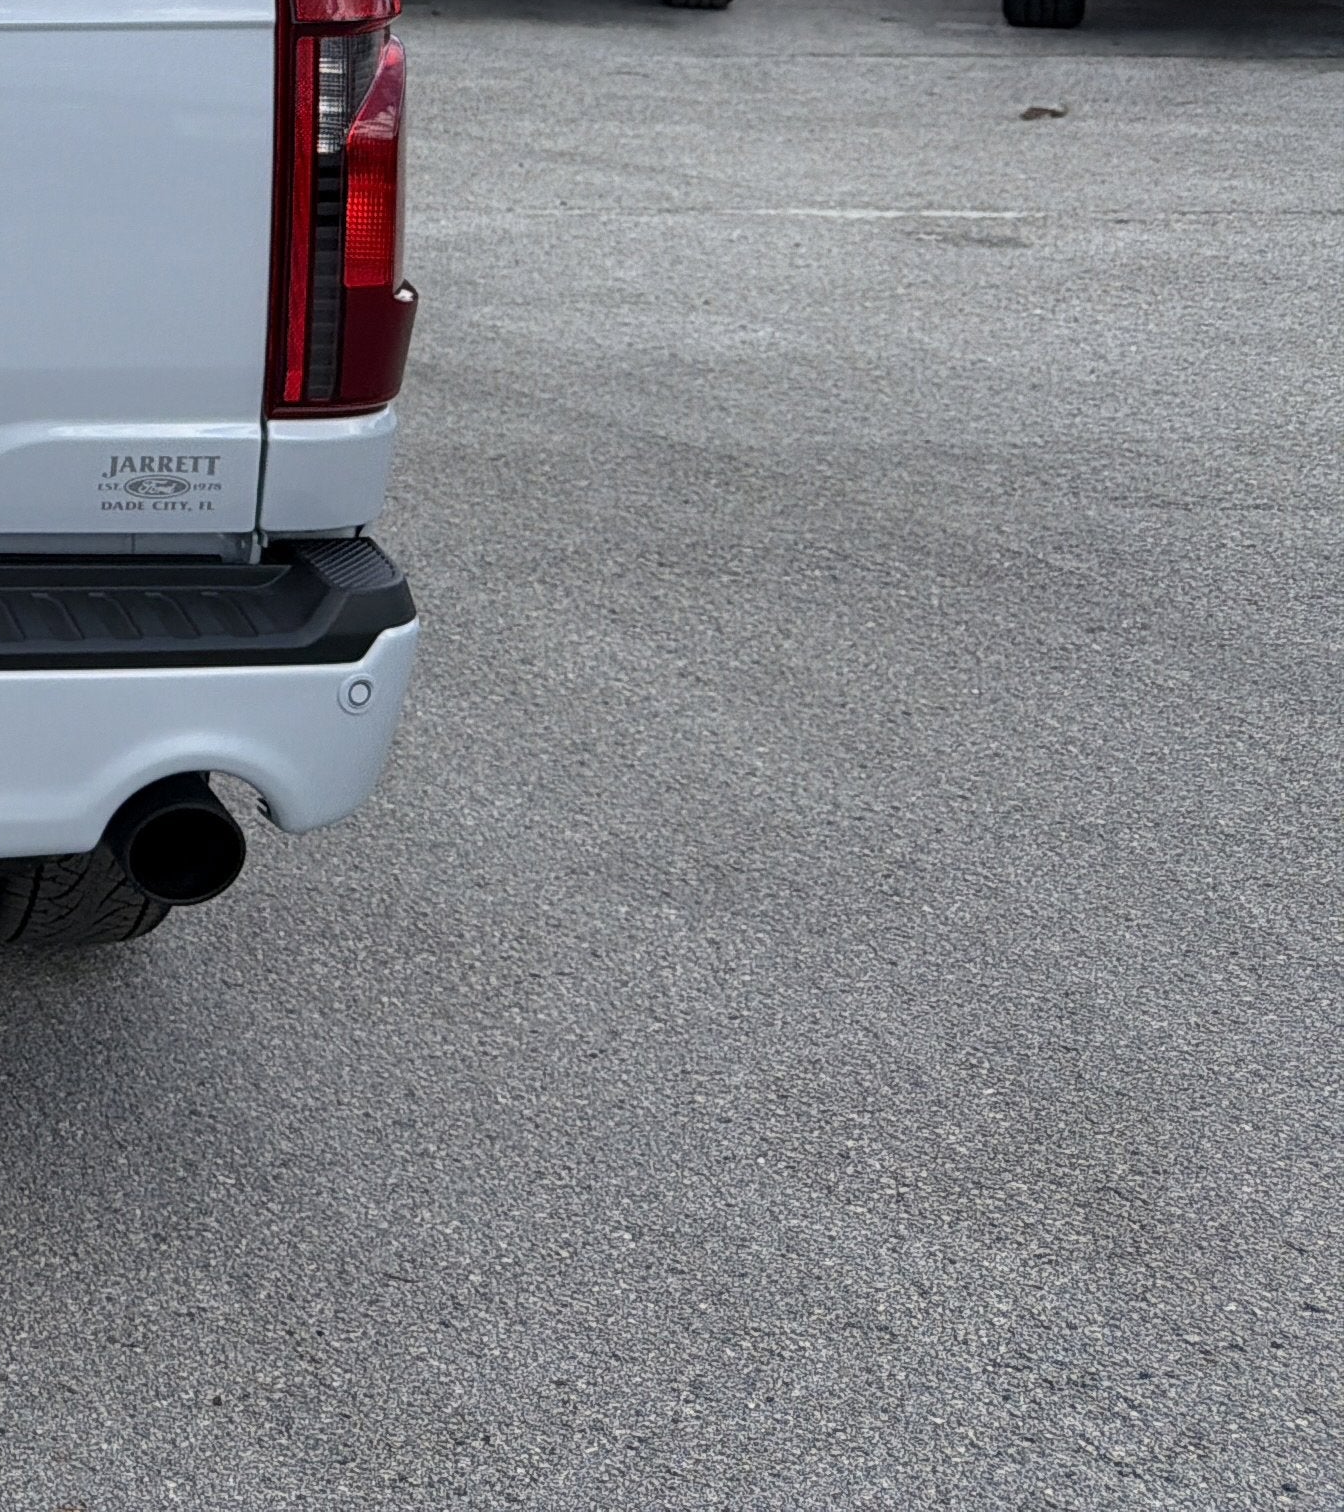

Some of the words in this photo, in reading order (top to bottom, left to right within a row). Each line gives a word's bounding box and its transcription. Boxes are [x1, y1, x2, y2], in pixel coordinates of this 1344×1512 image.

[102, 455, 221, 478] JARRETT
[101, 500, 146, 512] DADE
[152, 500, 193, 513] CITY,
[198, 500, 215, 512] FL
